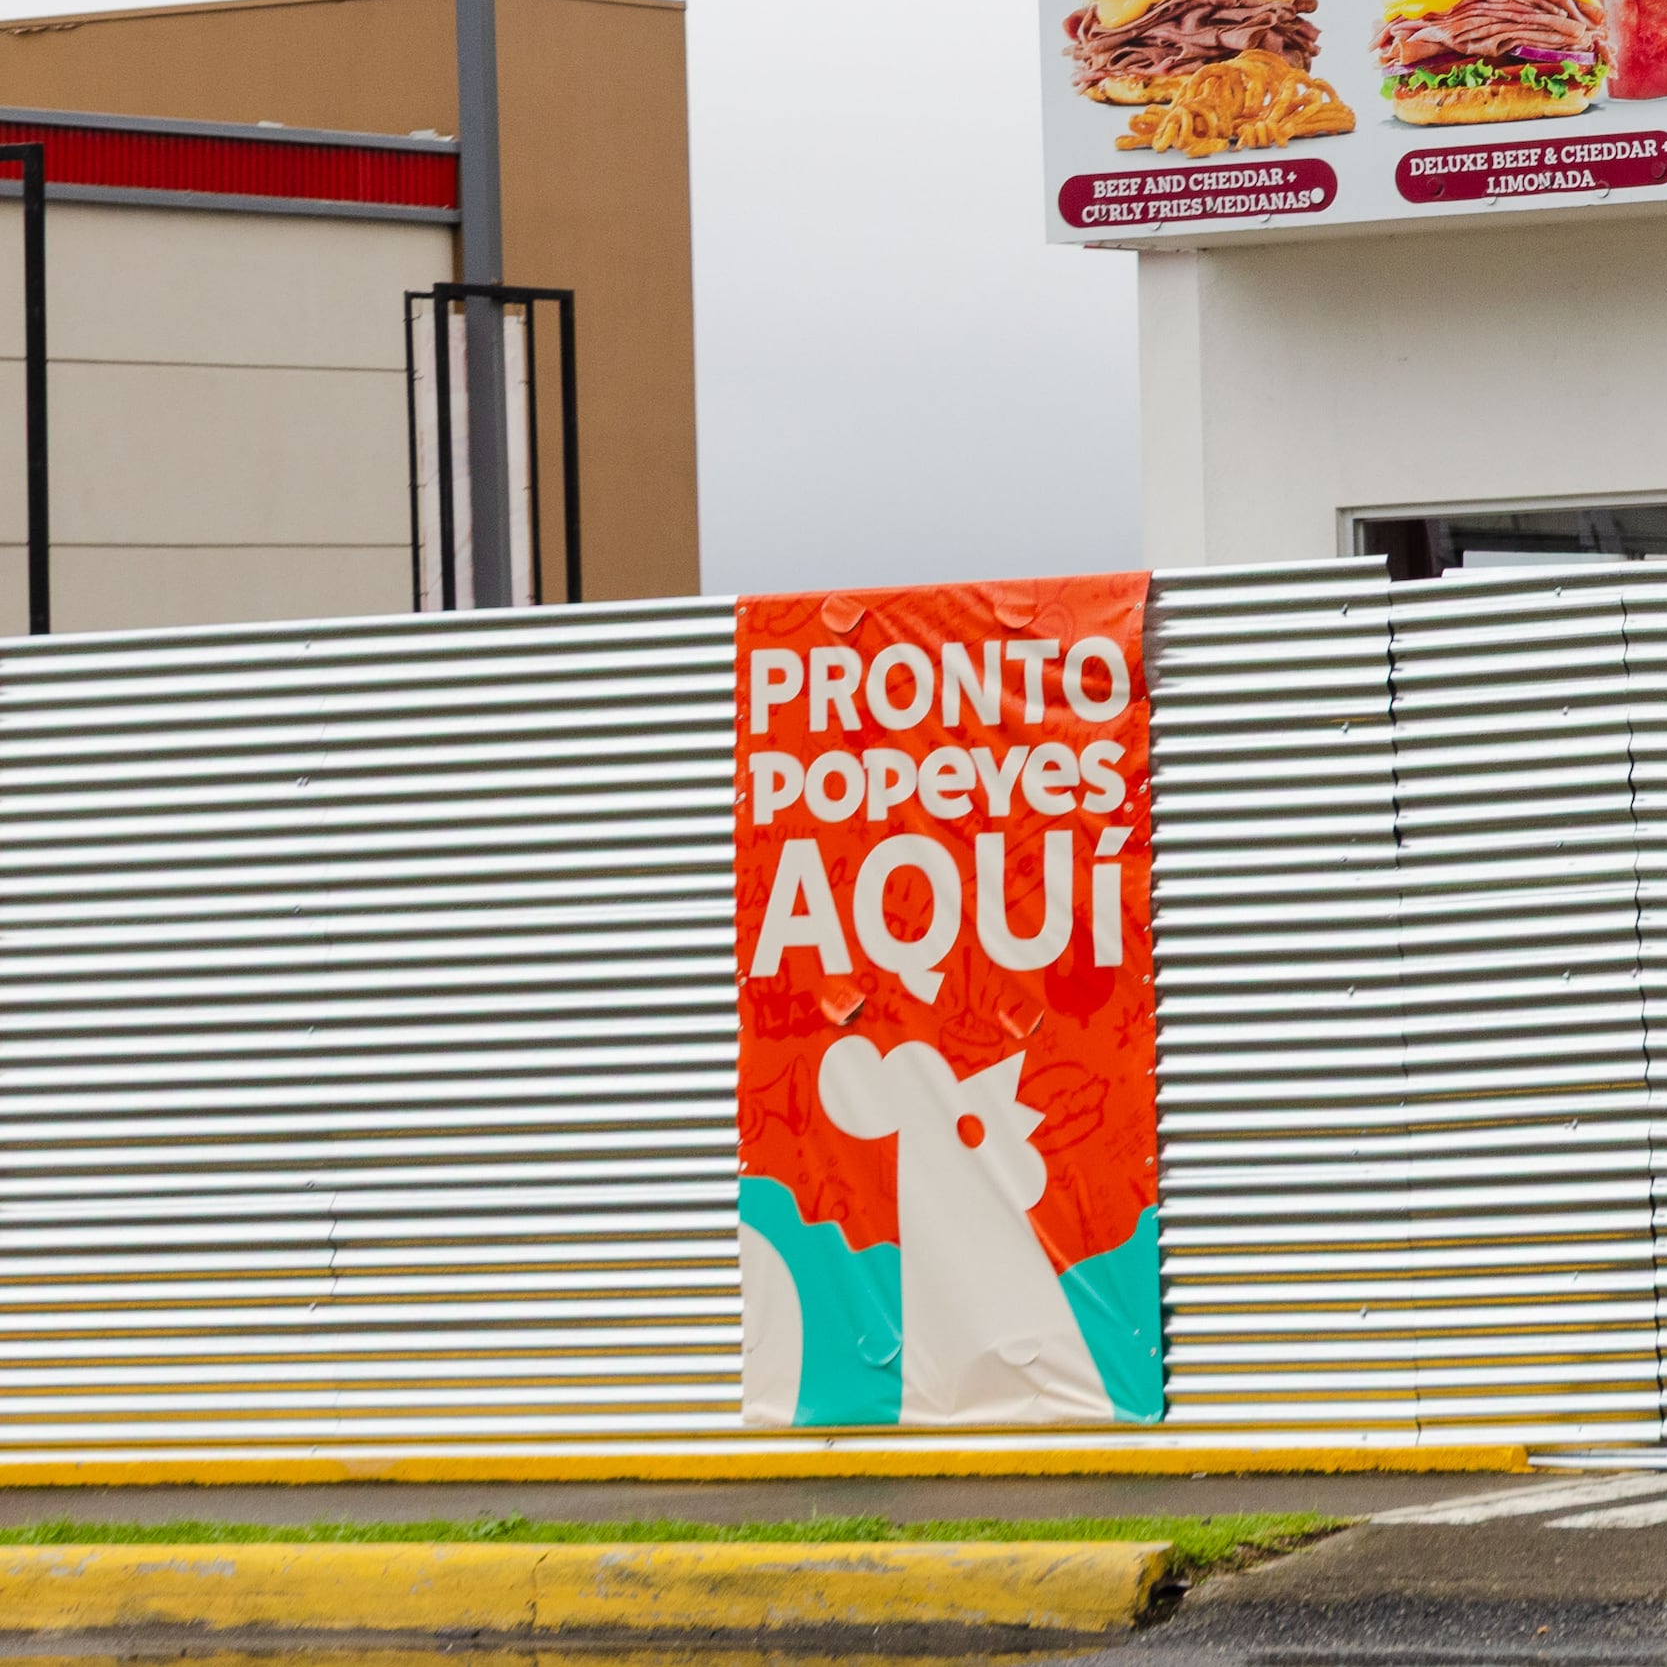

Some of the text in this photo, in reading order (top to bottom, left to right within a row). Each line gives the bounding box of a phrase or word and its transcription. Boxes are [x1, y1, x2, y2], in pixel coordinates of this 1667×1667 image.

[1410, 154, 1488, 177] DELUXE
[1491, 148, 1541, 170] BEEF
[1544, 148, 1558, 165] &
[1560, 139, 1658, 164] CHEDDAR
[1093, 168, 1298, 199] BEEF AND CHEDDAR +
[1486, 169, 1596, 195] LIMONADA
[1081, 190, 1311, 224] CURLY FRIES MEDIANAS
[749, 636, 1131, 735] PRONTO
